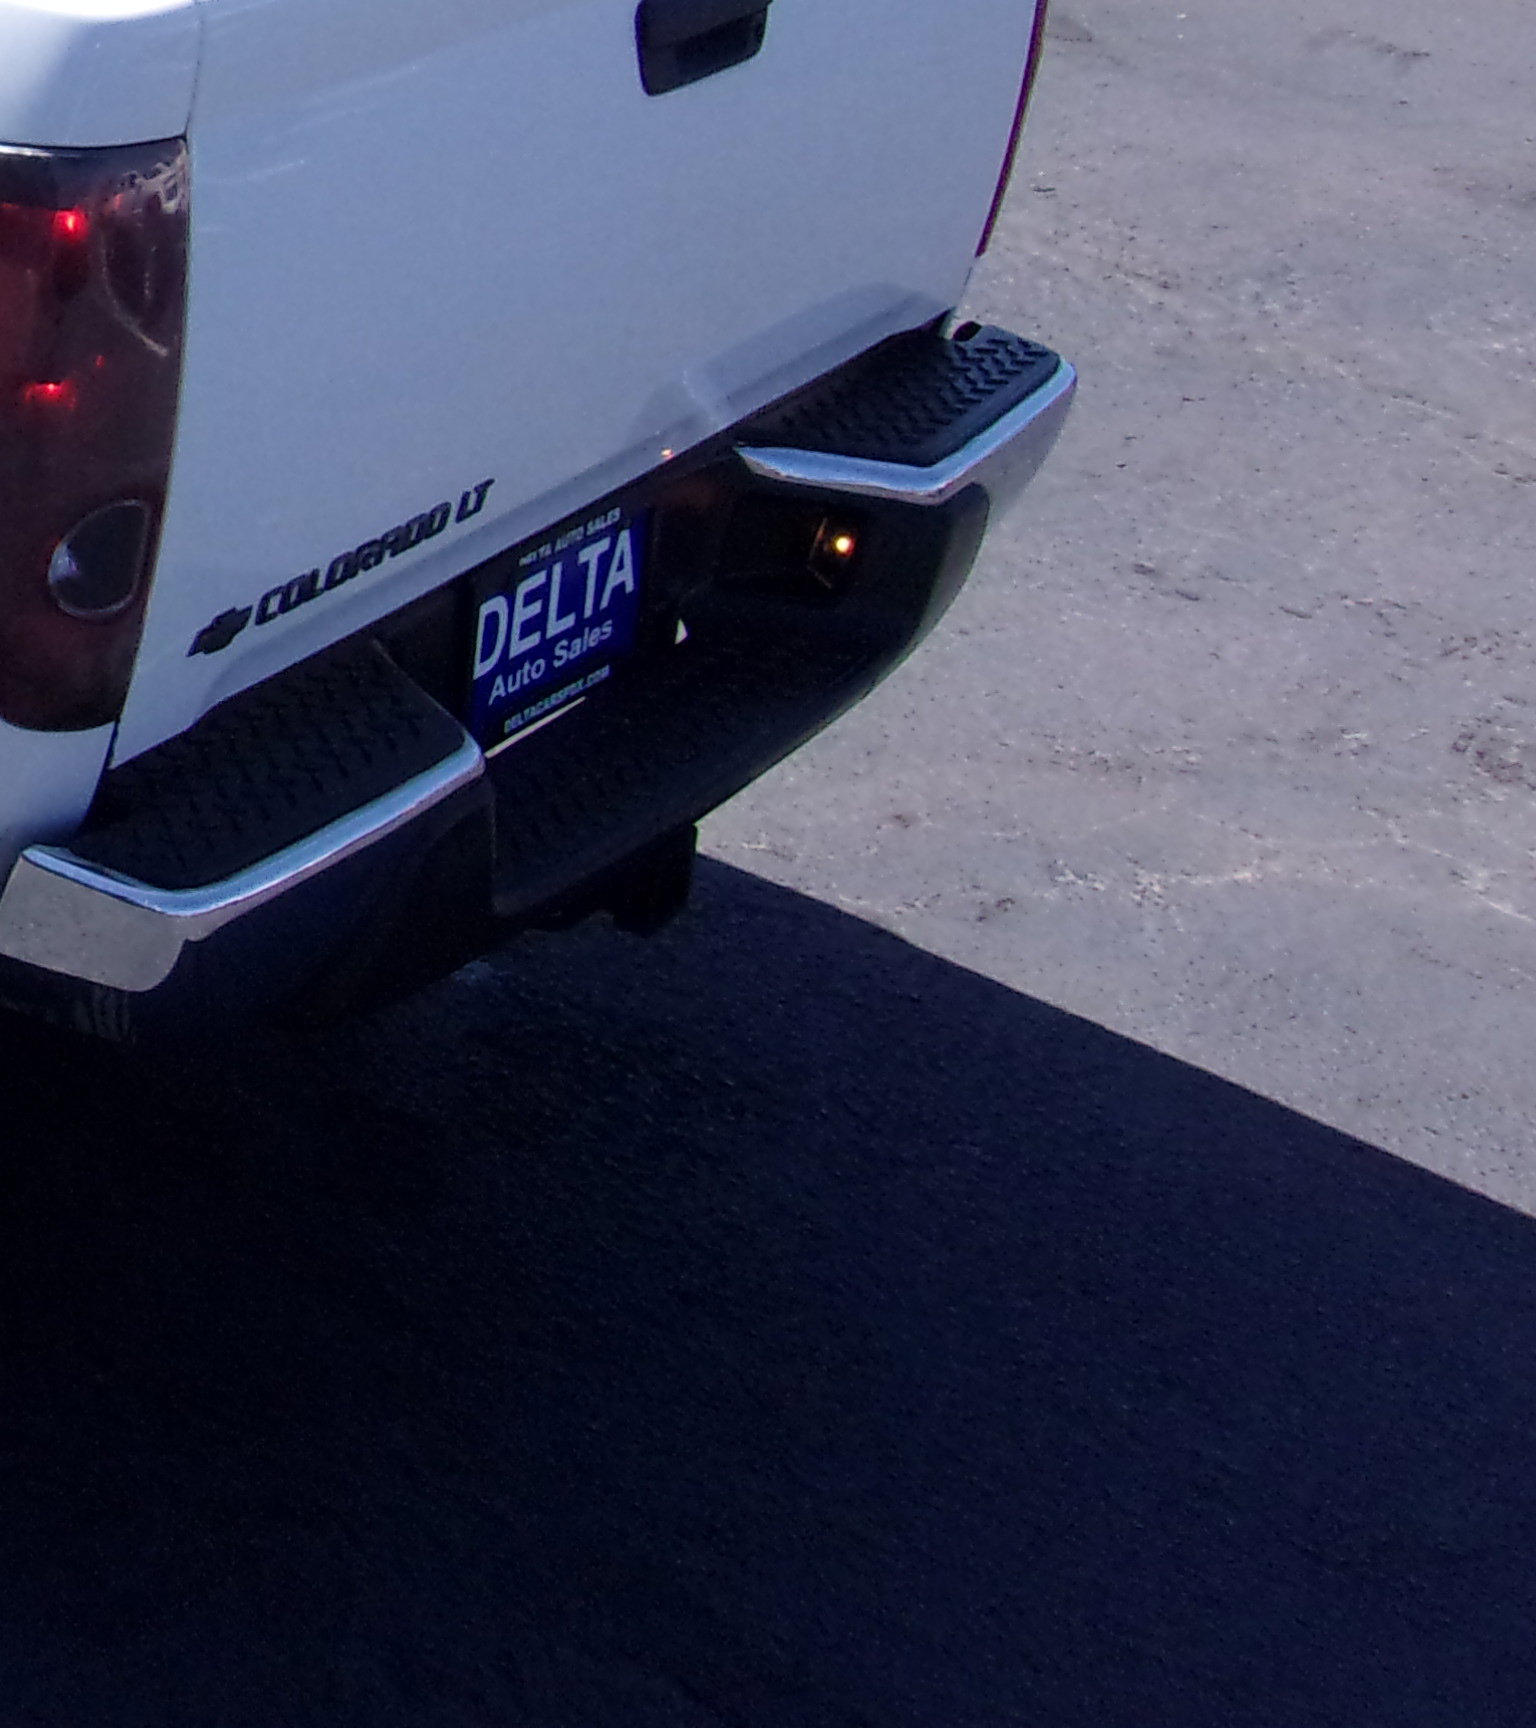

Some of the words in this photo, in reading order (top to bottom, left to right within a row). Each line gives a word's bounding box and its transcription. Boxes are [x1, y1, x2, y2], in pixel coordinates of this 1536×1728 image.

[254, 501, 452, 626] COLORADO
[455, 478, 496, 524] LT
[473, 528, 635, 680] DELTA
[488, 658, 546, 707] Auto
[552, 620, 613, 668] Sales
